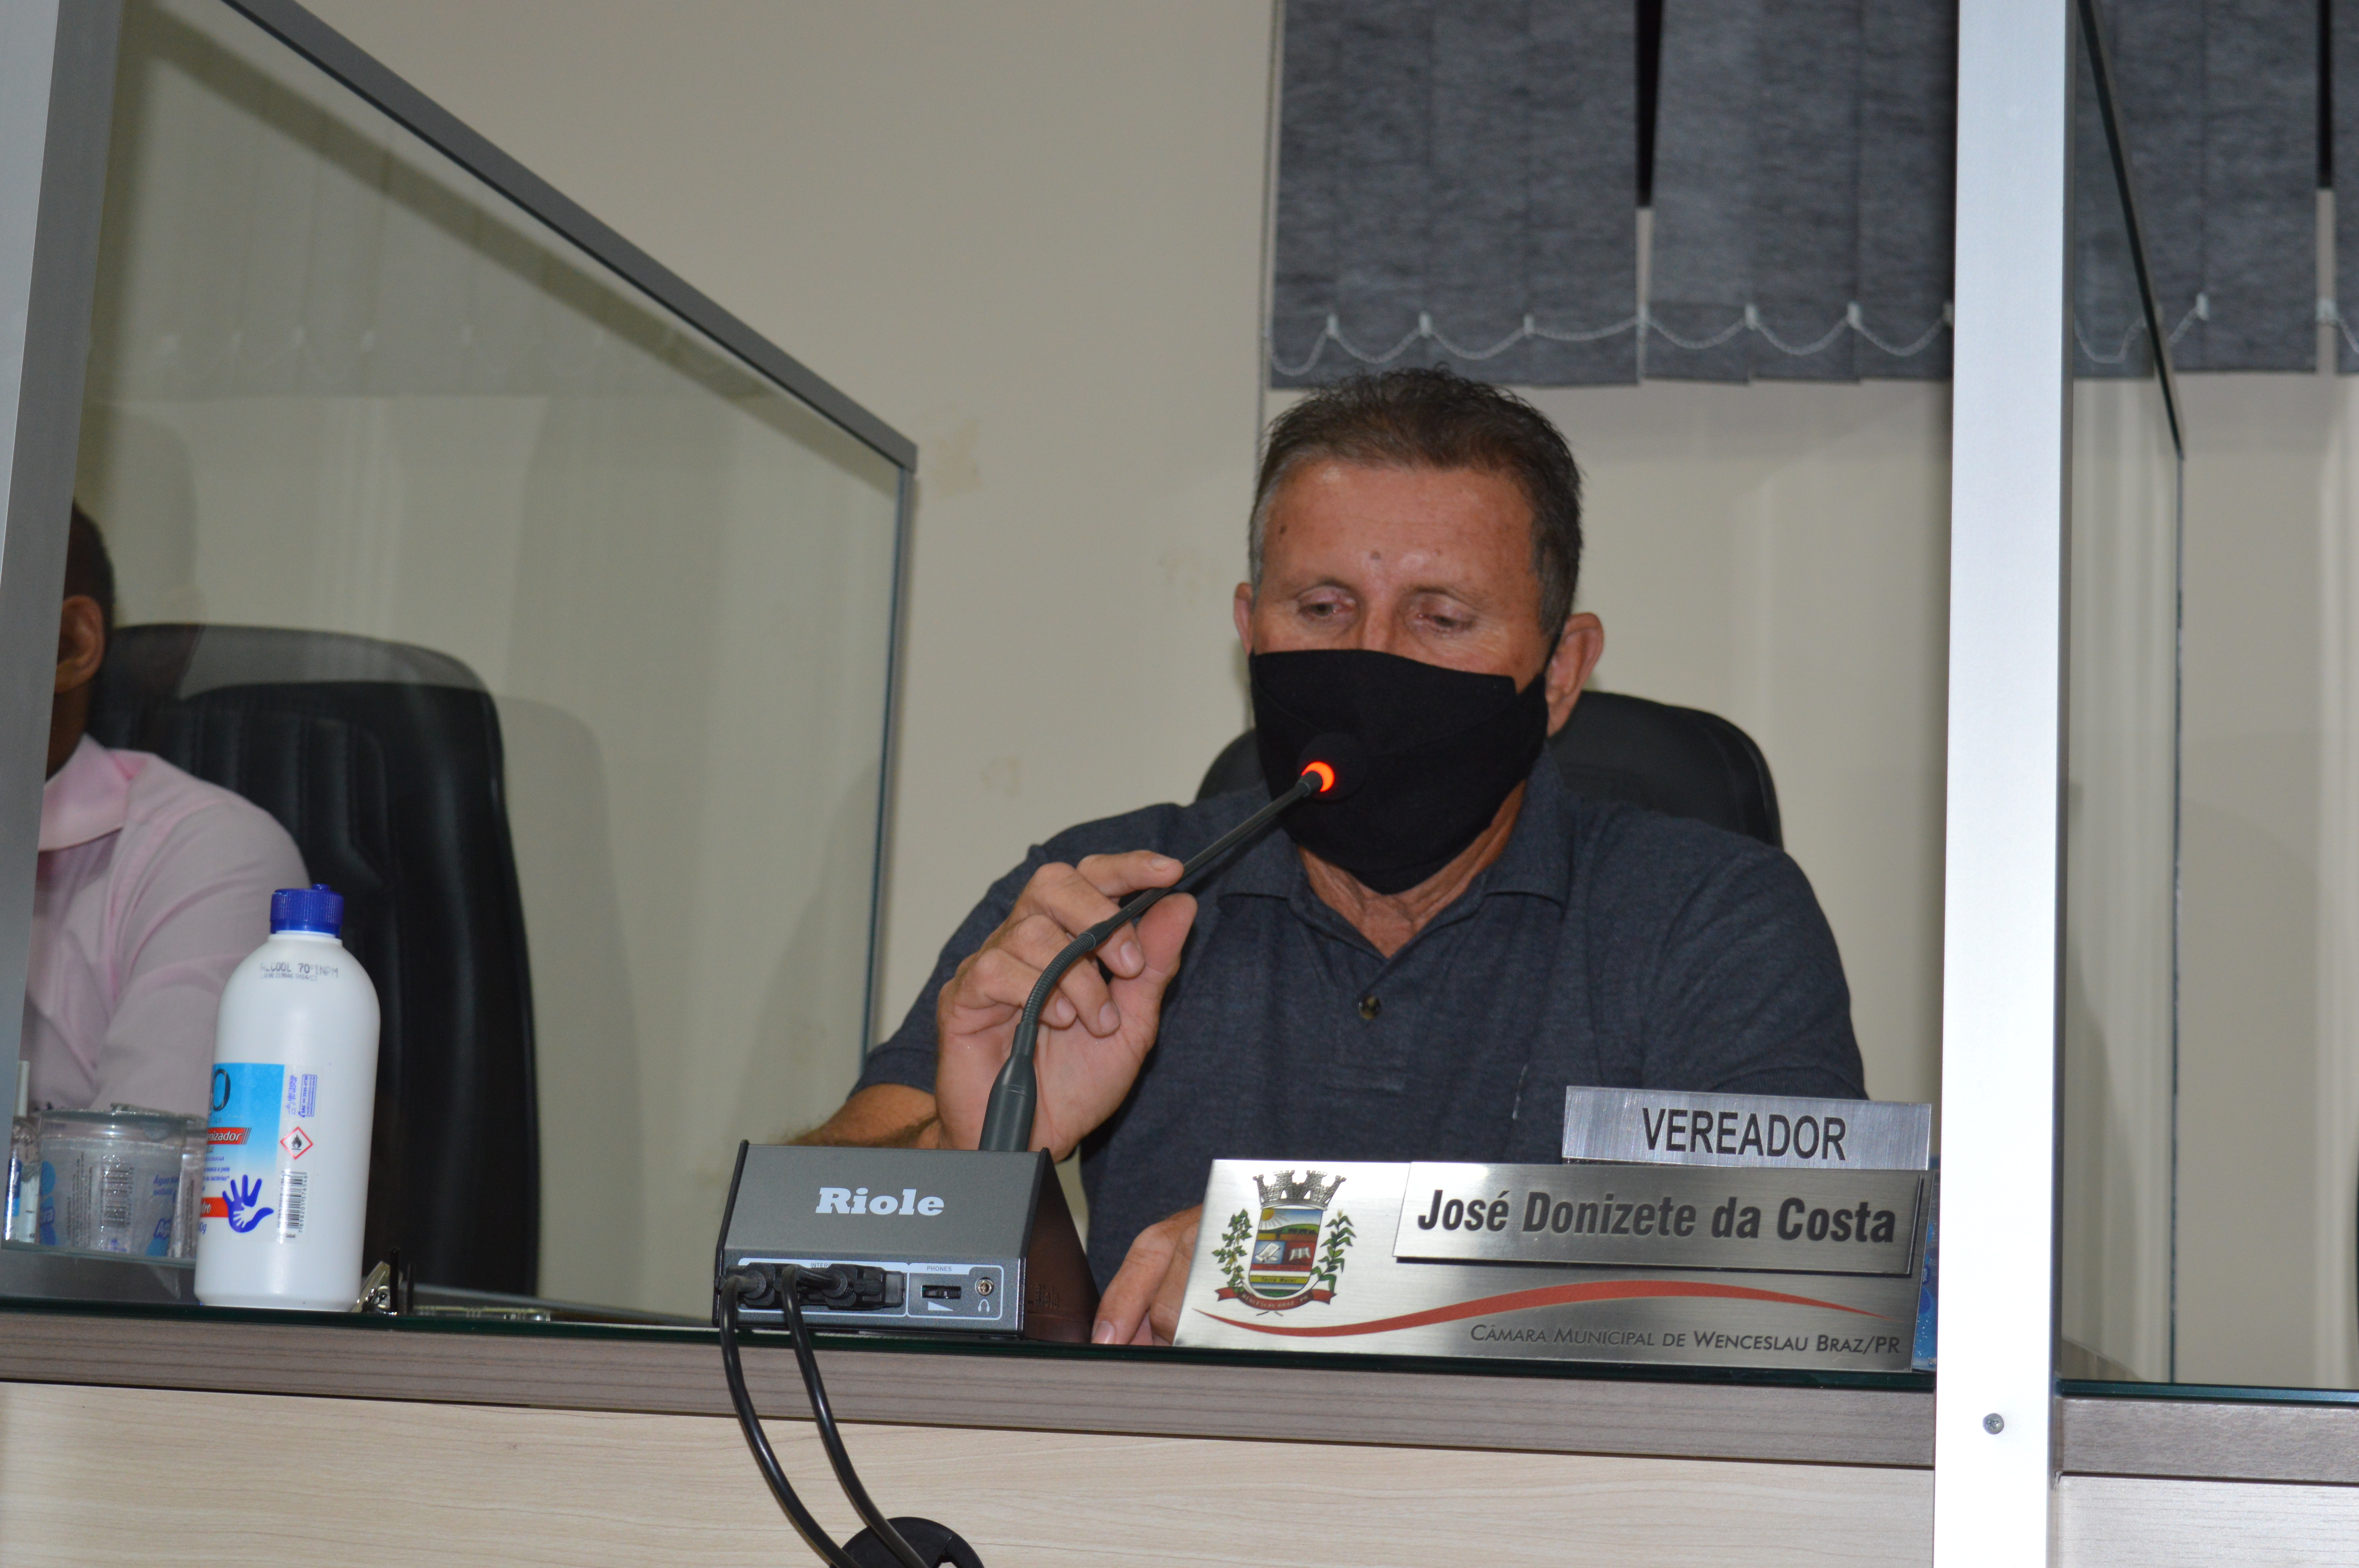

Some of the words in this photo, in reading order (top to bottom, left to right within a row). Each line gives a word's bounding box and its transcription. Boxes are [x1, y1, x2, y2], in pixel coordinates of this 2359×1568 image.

[1642, 1107, 1846, 1161] VEREADOR
[815, 1187, 944, 1216] Riole
[1418, 1189, 1510, 1231] José
[1522, 1191, 1697, 1237] Donizete
[1711, 1196, 1761, 1239] da
[1777, 1197, 1896, 1243] Costa
[1470, 1324, 1547, 1343] CÂMARA
[1553, 1328, 1655, 1346] MUNICIPAL
[1662, 1333, 1686, 1347] DE
[1694, 1331, 1808, 1351] WENCESLAU
